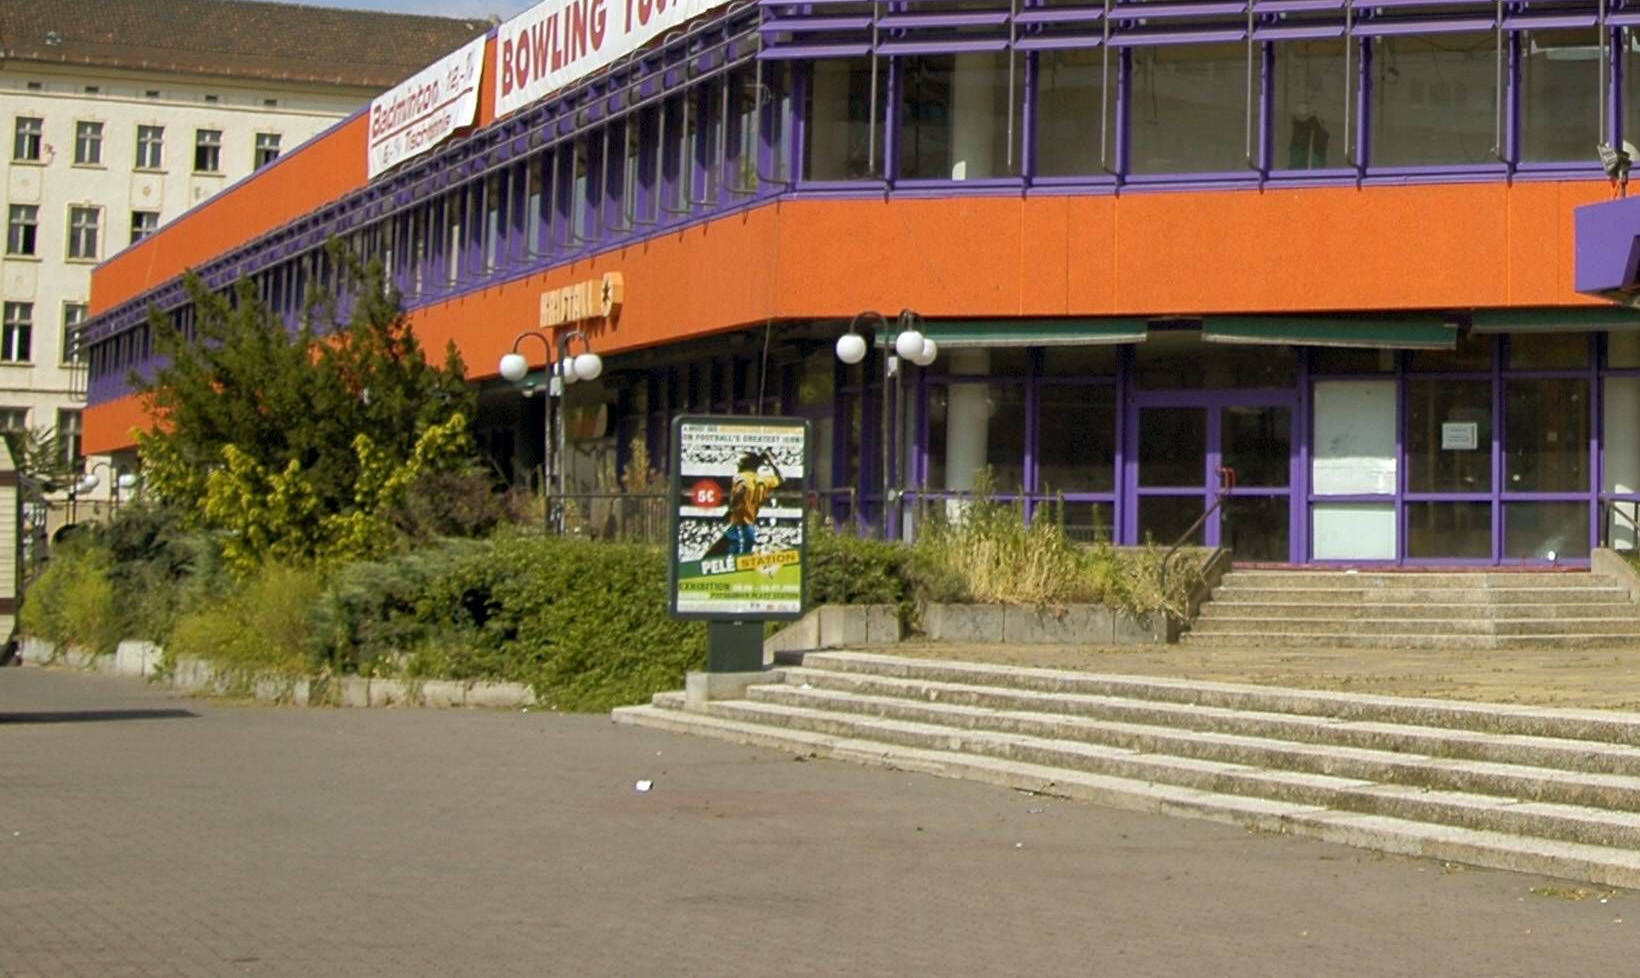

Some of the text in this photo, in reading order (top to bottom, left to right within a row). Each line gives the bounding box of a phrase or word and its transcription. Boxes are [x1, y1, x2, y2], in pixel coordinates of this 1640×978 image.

[372, 80, 439, 139] Badminton
[702, 552, 796, 575] PELÉ STATION
